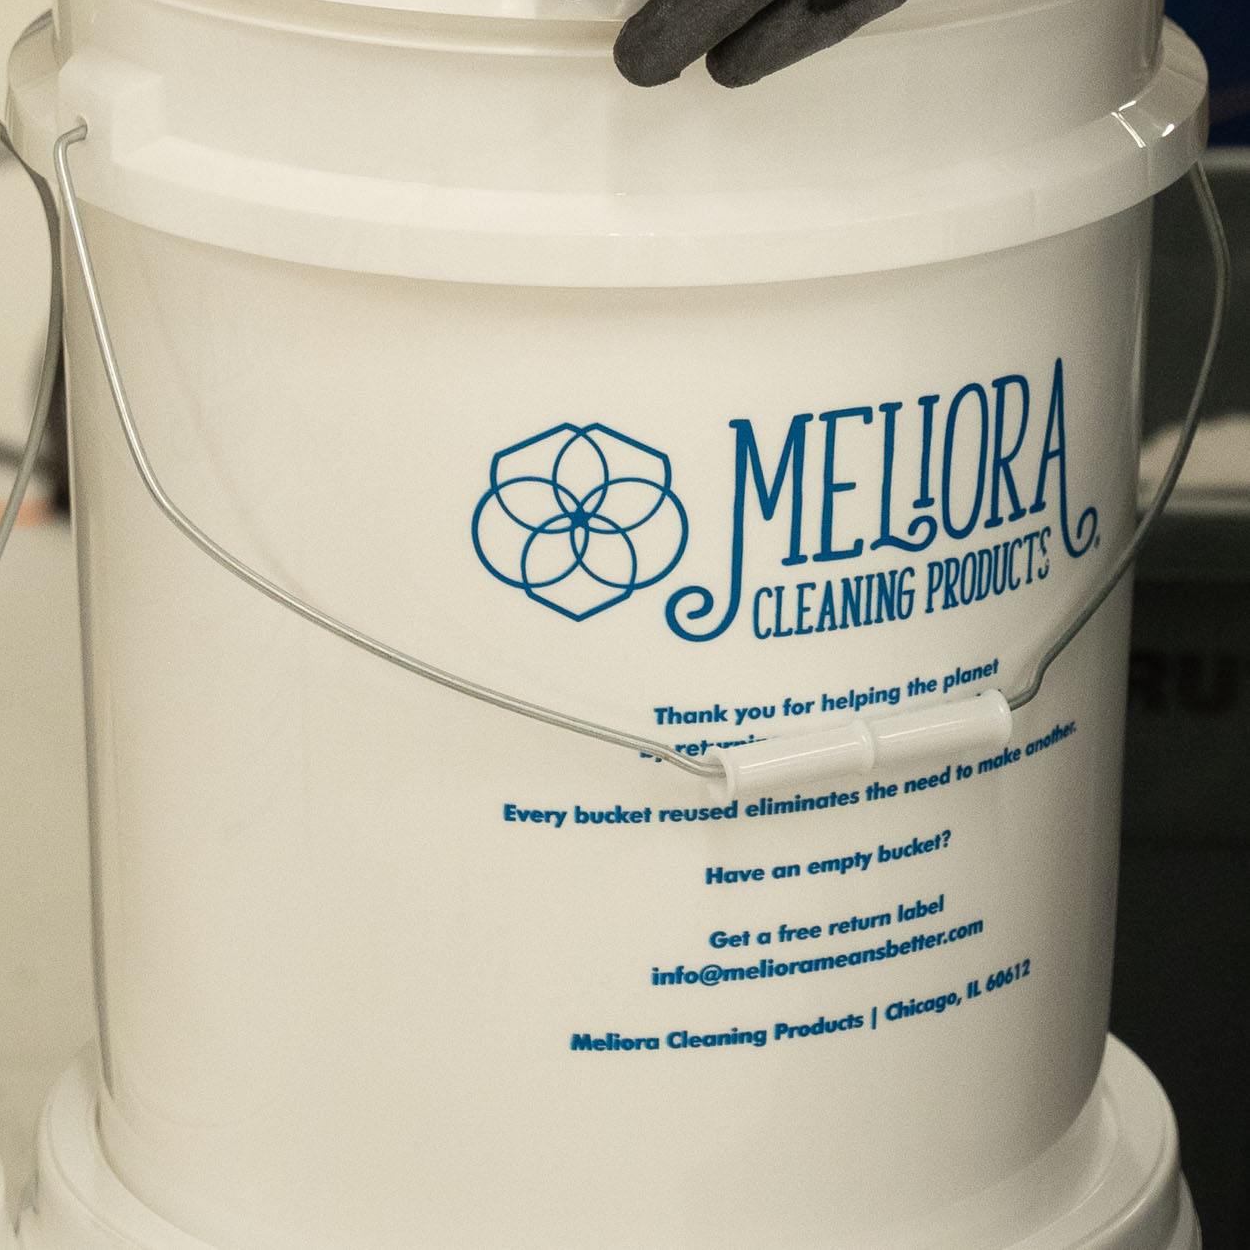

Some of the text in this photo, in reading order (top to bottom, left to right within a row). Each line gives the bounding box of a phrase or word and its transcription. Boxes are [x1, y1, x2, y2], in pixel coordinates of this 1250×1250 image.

[665, 357, 1097, 643] MELIORA
[752, 526, 1052, 640] CLEANING PRODUCTS
[654, 658, 1000, 726] Thank you for helping the planet
[502, 722, 1076, 829] Every bucket reused eliminates the need to make another.
[704, 830, 952, 885] Have an empty bucket?
[650, 912, 984, 987] info@meliorameansbetter.com
[707, 894, 945, 950] Get a free return label
[569, 1032, 660, 1052] Meliora
[665, 1027, 768, 1050] Cleaning
[773, 1014, 865, 1041] Products
[883, 992, 962, 1022] Chicago,
[966, 980, 982, 999] IL
[984, 959, 1030, 992] 60612
